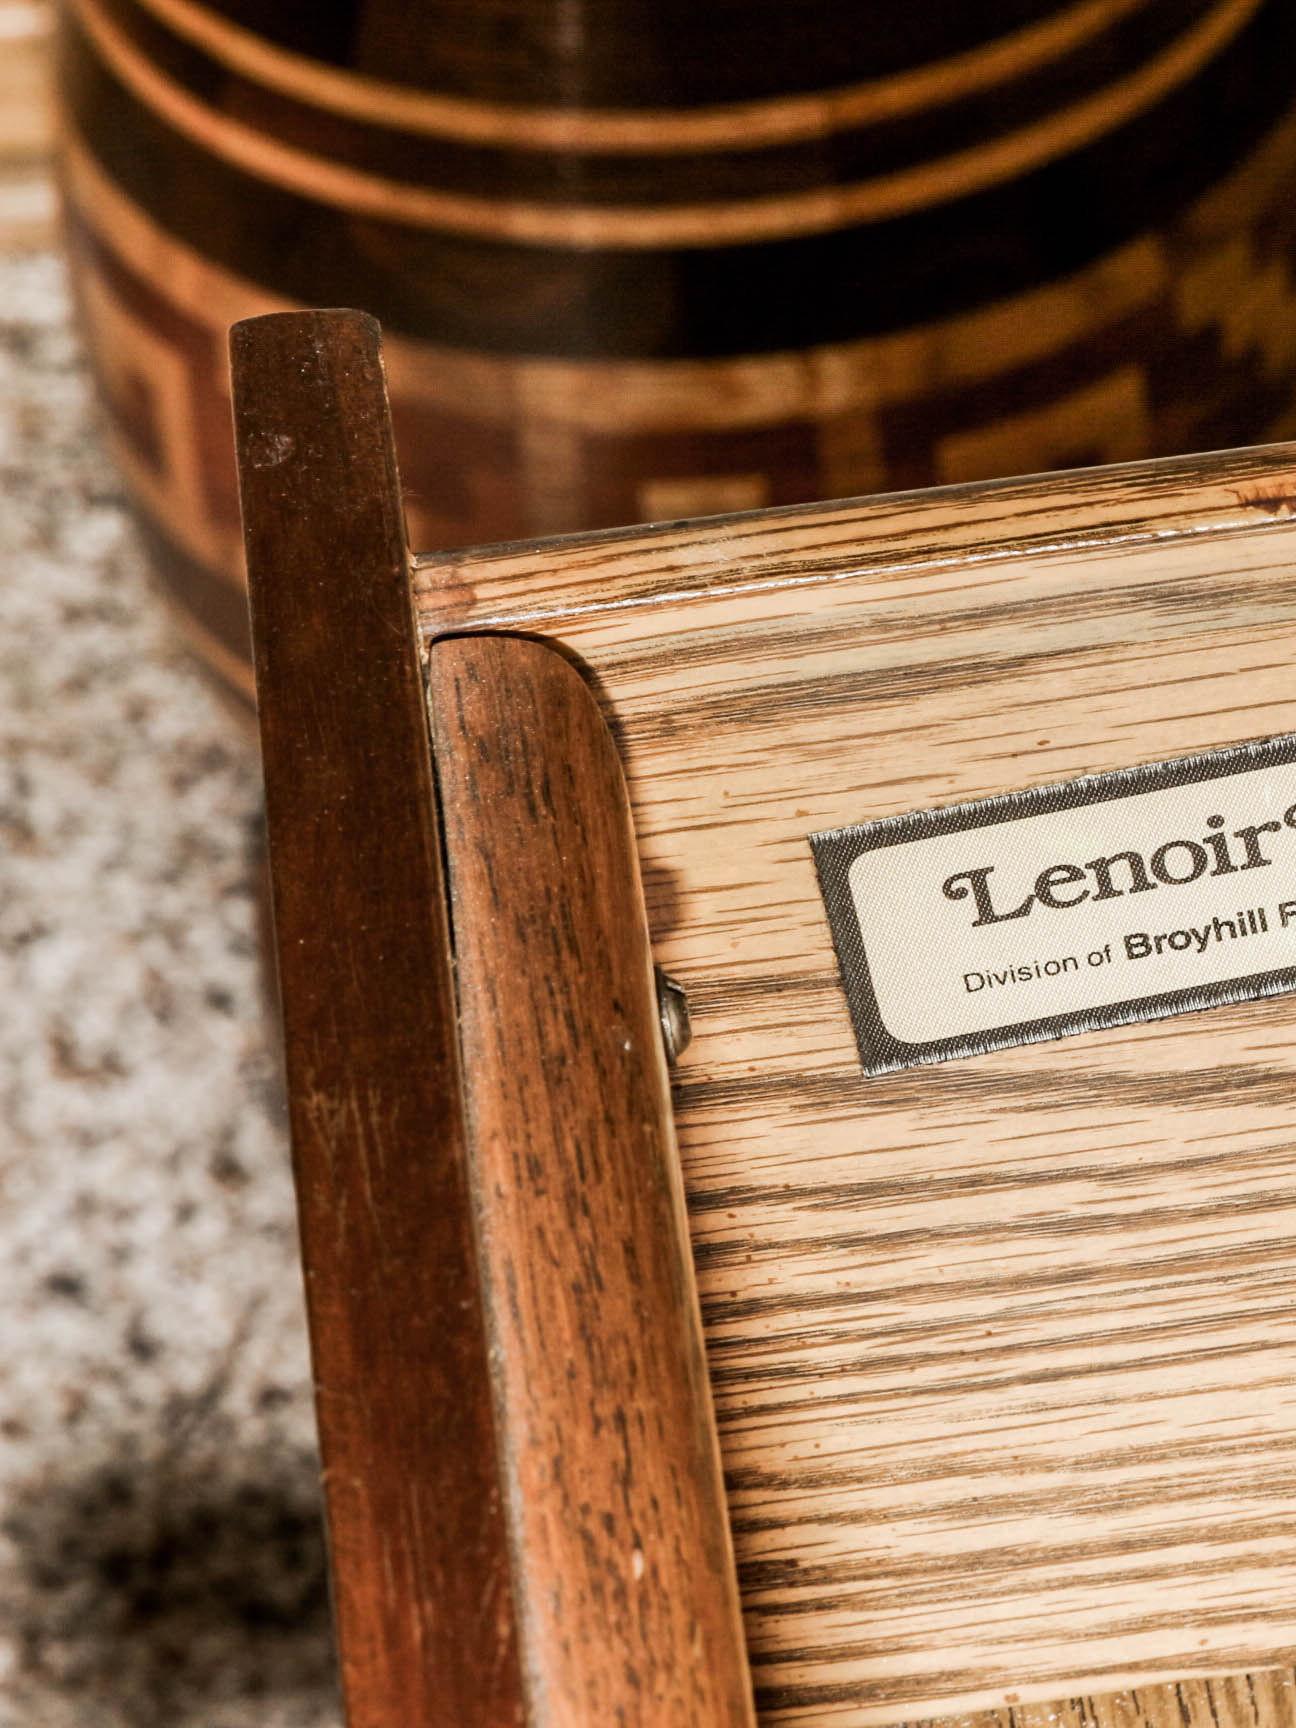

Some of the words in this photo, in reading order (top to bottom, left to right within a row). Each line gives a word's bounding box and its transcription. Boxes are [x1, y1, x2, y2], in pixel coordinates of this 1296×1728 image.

[942, 814, 1282, 928] Lenoir
[964, 953, 1079, 994] Division
[1087, 946, 1114, 968] of
[1123, 907, 1269, 961] Broyhill
